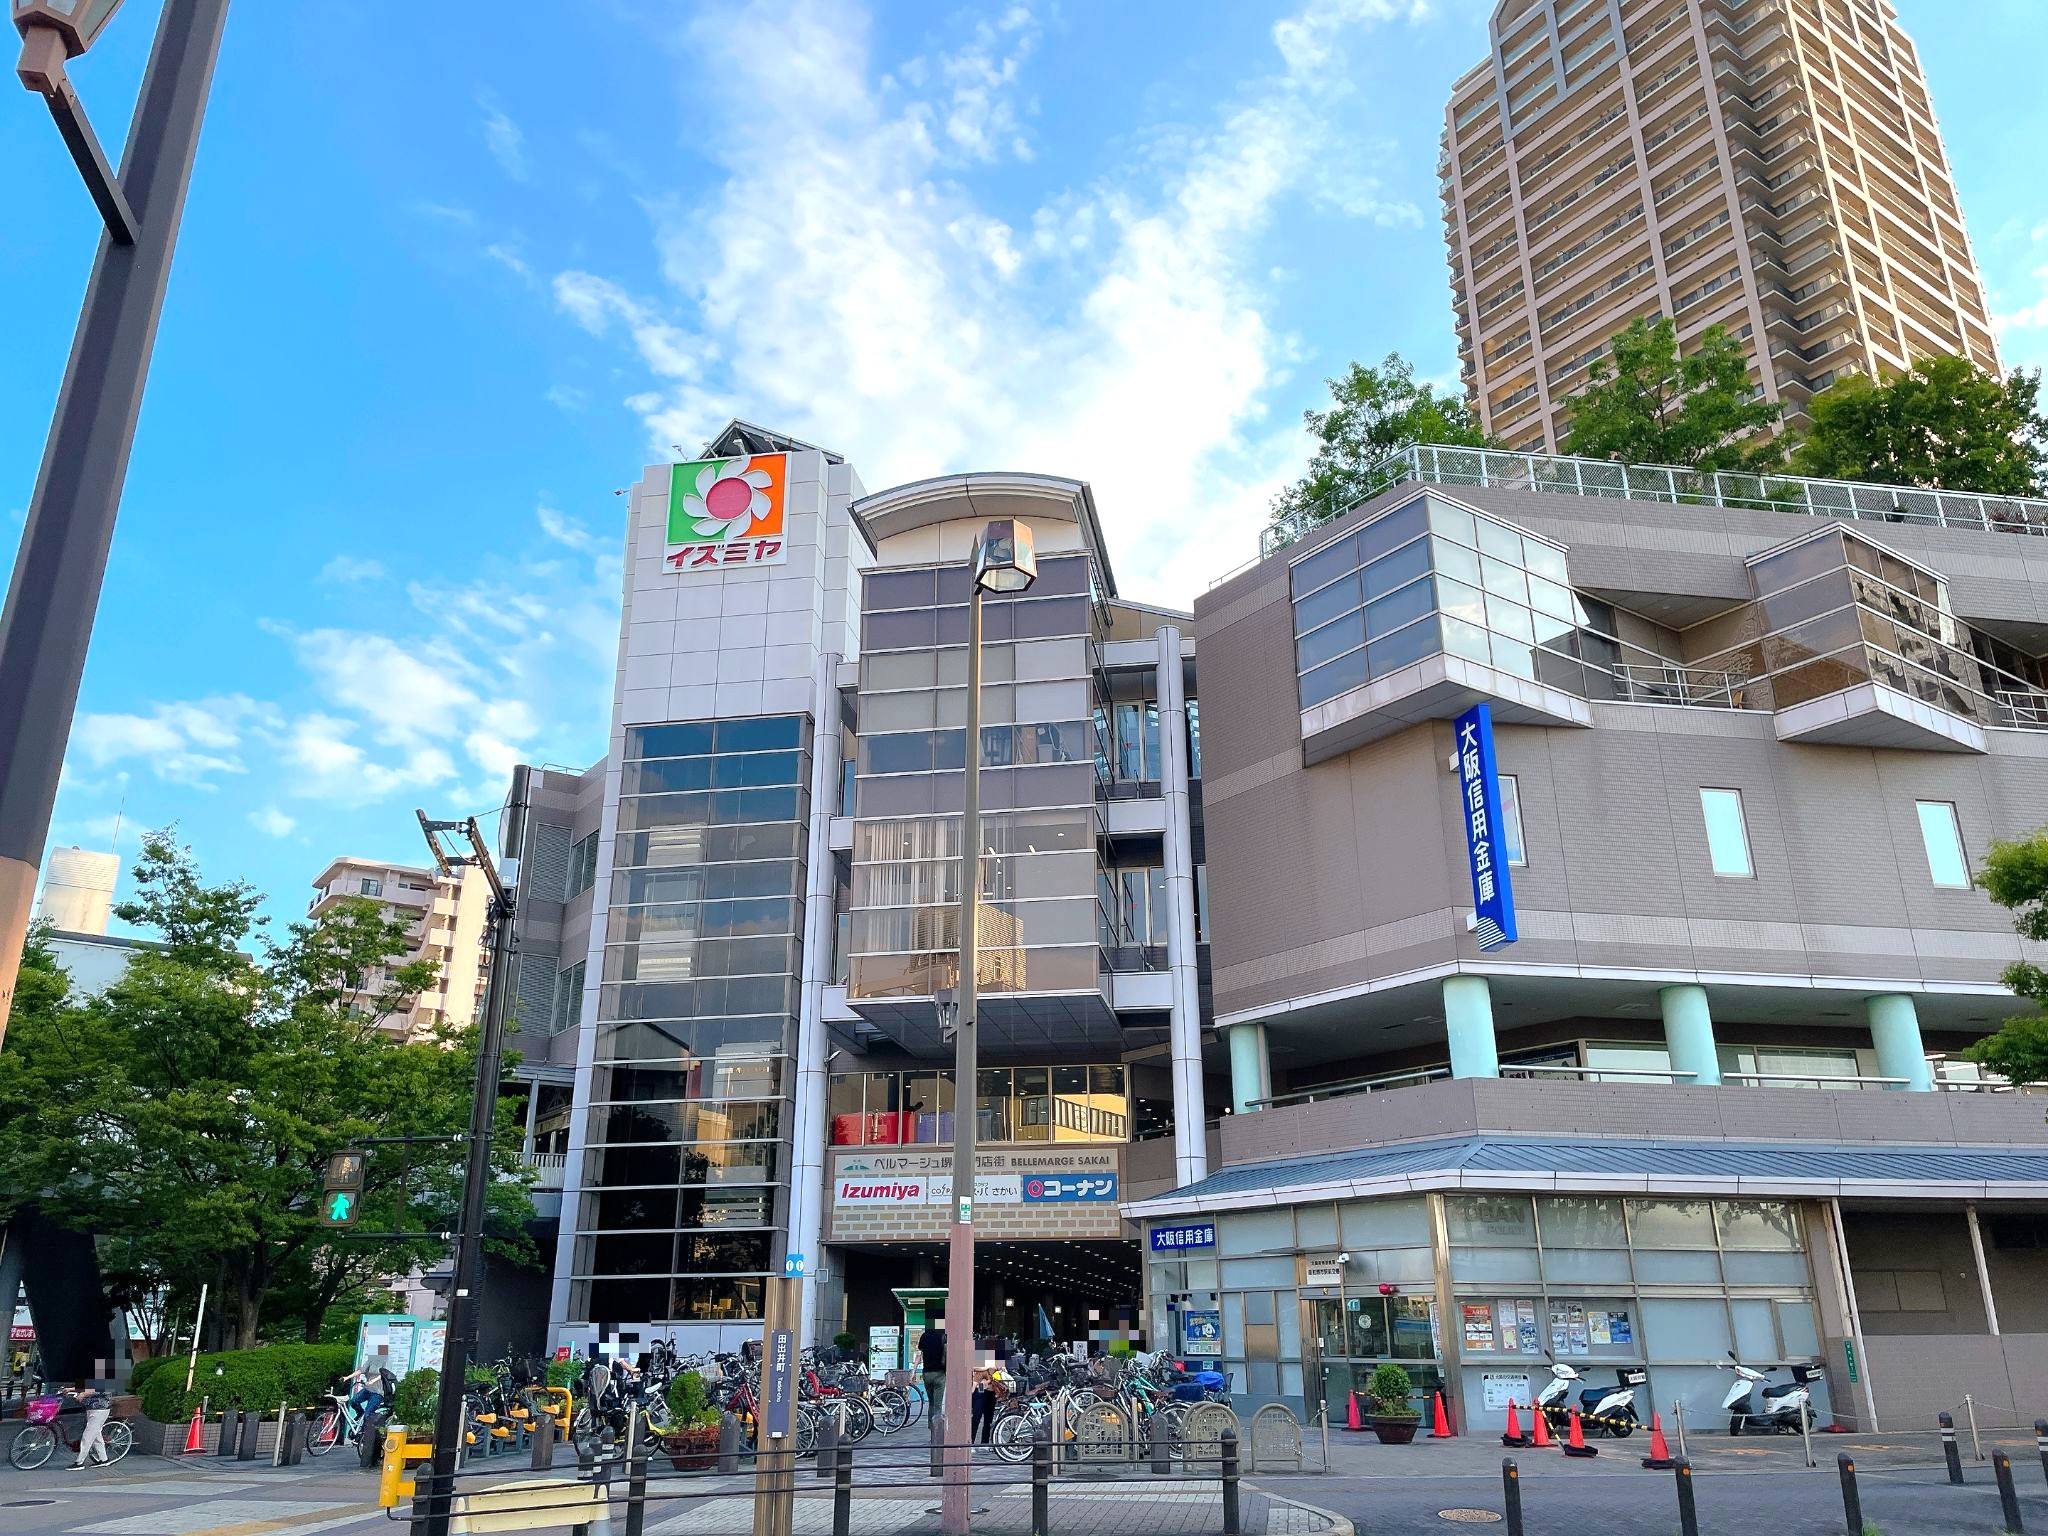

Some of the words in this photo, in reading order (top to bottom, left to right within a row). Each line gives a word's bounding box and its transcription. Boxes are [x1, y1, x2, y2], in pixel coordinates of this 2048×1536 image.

[666, 540, 782, 569] イズミヤ
[1460, 721, 1496, 906] 大阪信用金庫
[1011, 1156, 1074, 1167] BELLEMARGE
[1078, 1155, 1110, 1165] SAKAI
[841, 1181, 920, 1201] Izumiya
[992, 1186, 1018, 1196] さかい
[1043, 1179, 1113, 1197] コーナン
[1156, 1227, 1214, 1247] 大阪信用金庫
[776, 1334, 787, 1373] 田出井町
